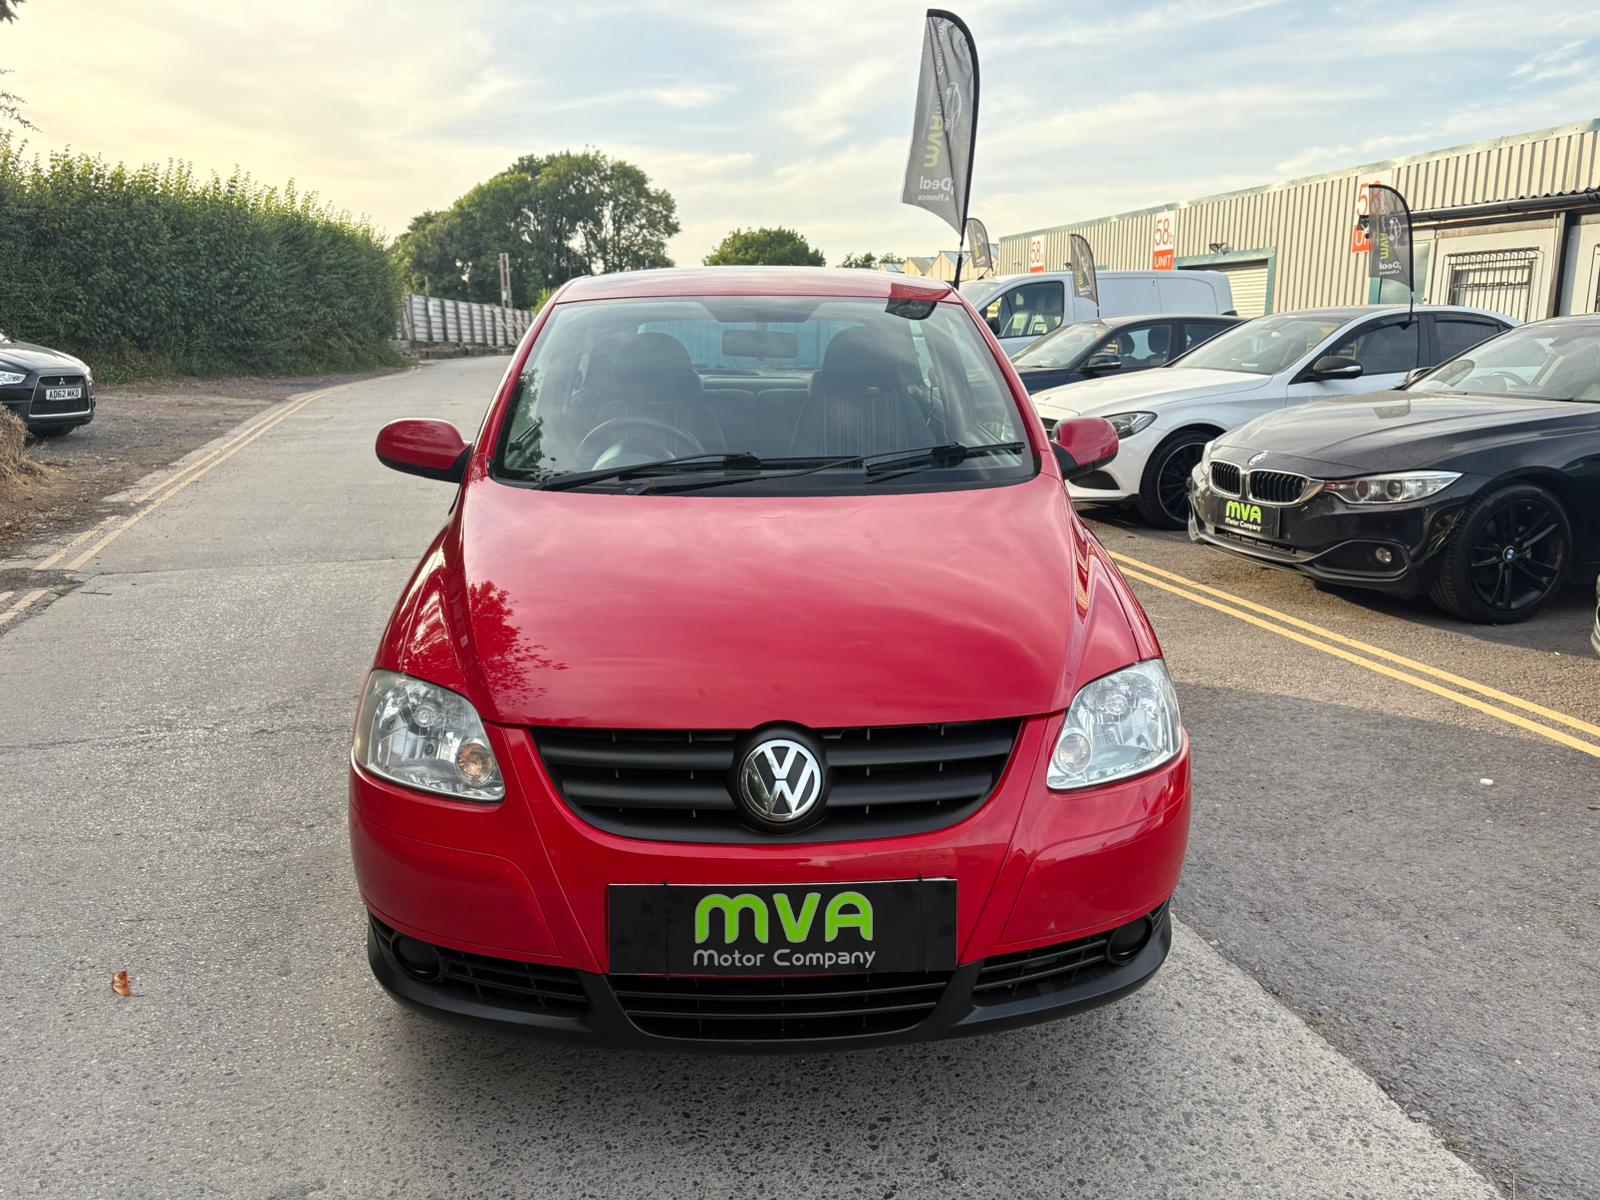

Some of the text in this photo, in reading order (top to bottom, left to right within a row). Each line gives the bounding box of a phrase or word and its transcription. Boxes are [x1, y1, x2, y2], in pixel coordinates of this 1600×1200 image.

[1154, 254, 1173, 268] UNIT
[1226, 500, 1261, 524] MVA
[694, 891, 874, 944] MVA
[693, 949, 876, 969] Motor Company
